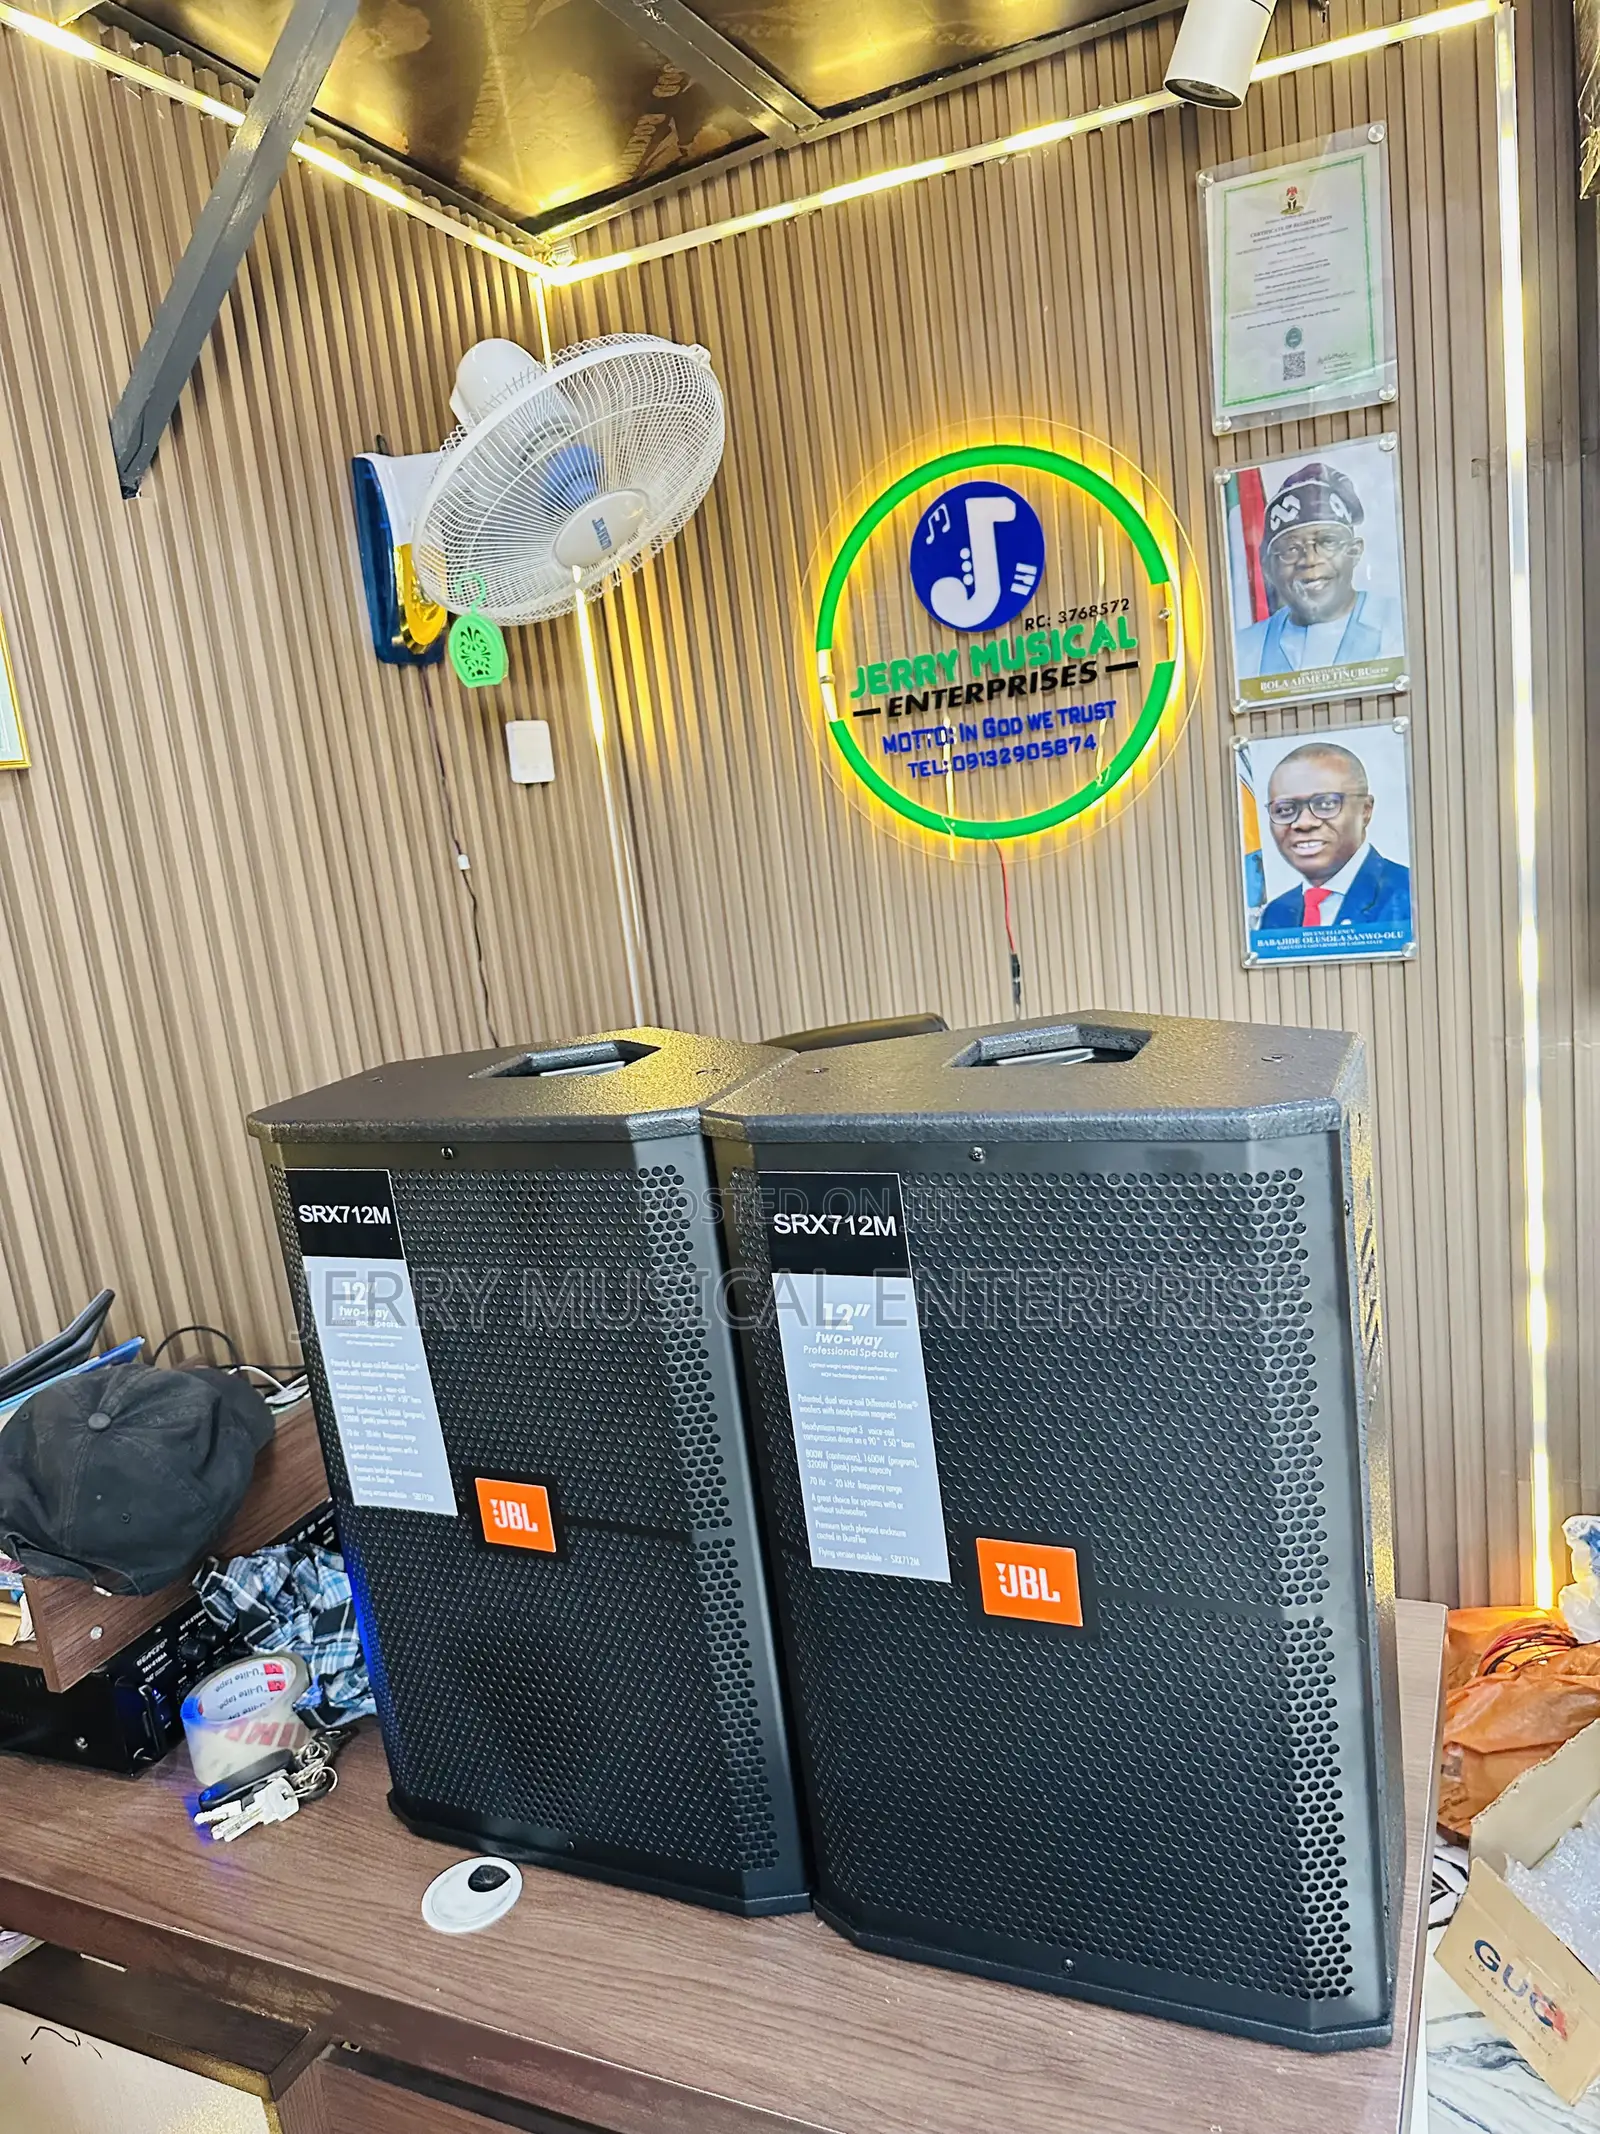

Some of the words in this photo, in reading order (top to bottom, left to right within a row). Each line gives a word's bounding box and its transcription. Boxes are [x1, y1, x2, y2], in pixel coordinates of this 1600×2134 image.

[1025, 613, 1050, 631] RC:
[1058, 598, 1130, 623] 3768572
[850, 648, 959, 699] JERRY
[970, 616, 1138, 676] MUSICAL
[887, 661, 1098, 718] ENTERPRISES
[1292, 673, 1329, 687] AHMED
[1027, 711, 1054, 731] WE
[1056, 700, 1116, 725] TRUST
[1257, 937, 1300, 947] BABAJIDE
[1302, 934, 1346, 943] OLUSOLA
[1347, 931, 1403, 940] SANWO-OLU
[298, 1204, 392, 1226] SRX712M
[773, 1213, 898, 1238] SRX712M
[804, 1345, 858, 1356] Professional
[860, 1348, 899, 1359] Speaker
[816, 1332, 883, 1349] two-way
[489, 1499, 538, 1533] JBL
[996, 1562, 1061, 1604] JBL
[234, 1668, 259, 1681] U-lite
[238, 1684, 264, 1698] U-lite
